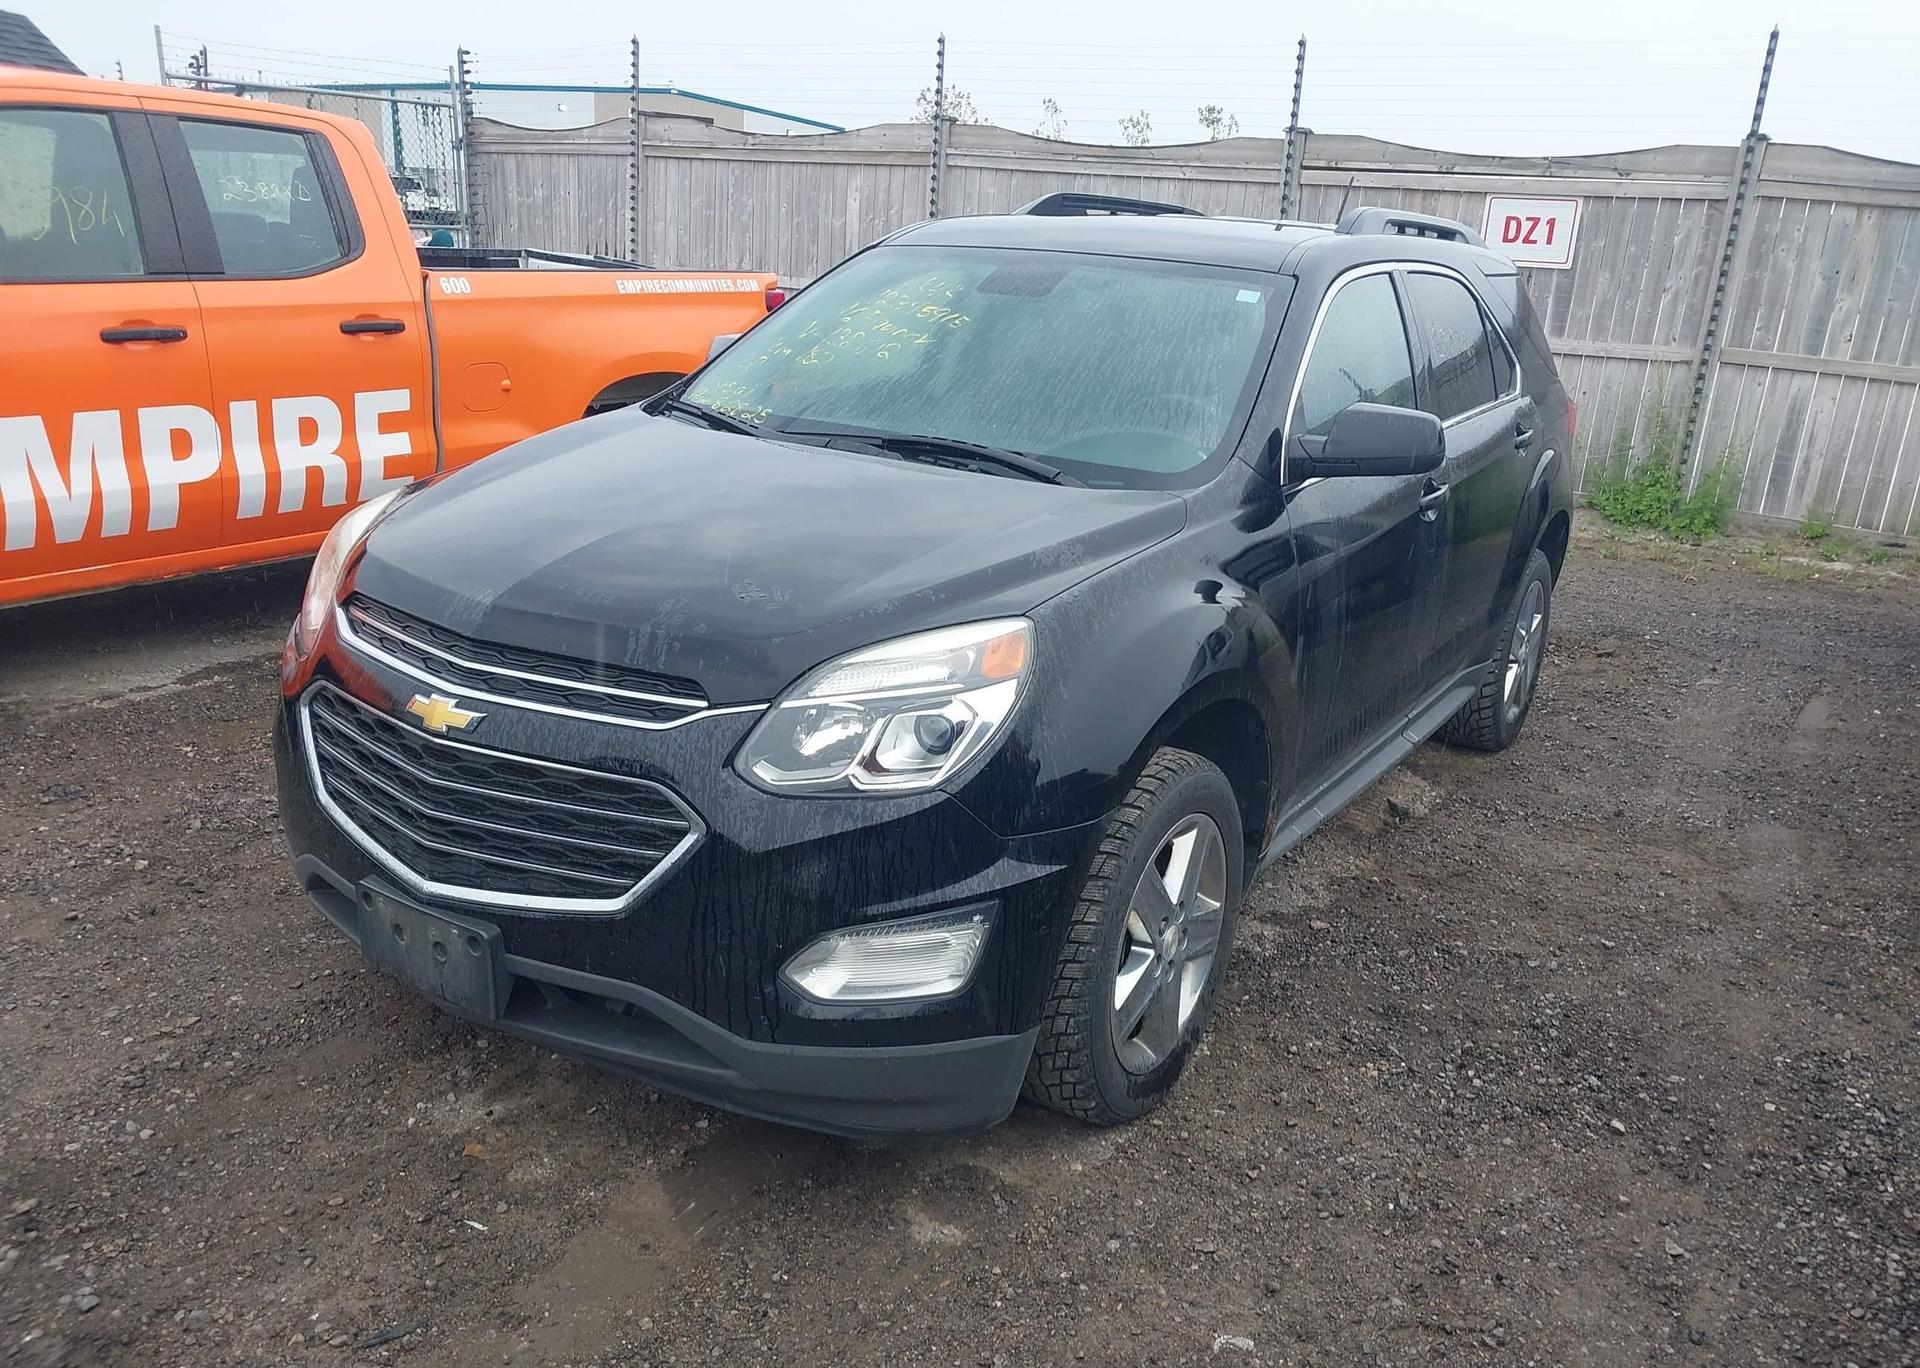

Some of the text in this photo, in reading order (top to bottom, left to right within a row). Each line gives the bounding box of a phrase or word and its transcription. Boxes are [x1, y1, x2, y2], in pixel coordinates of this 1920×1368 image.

[31, 184, 125, 245] 984
[1503, 216, 1556, 245] DZ1
[439, 276, 471, 294] 600
[616, 279, 759, 293] EMPIRECOMMUNITIES.COM
